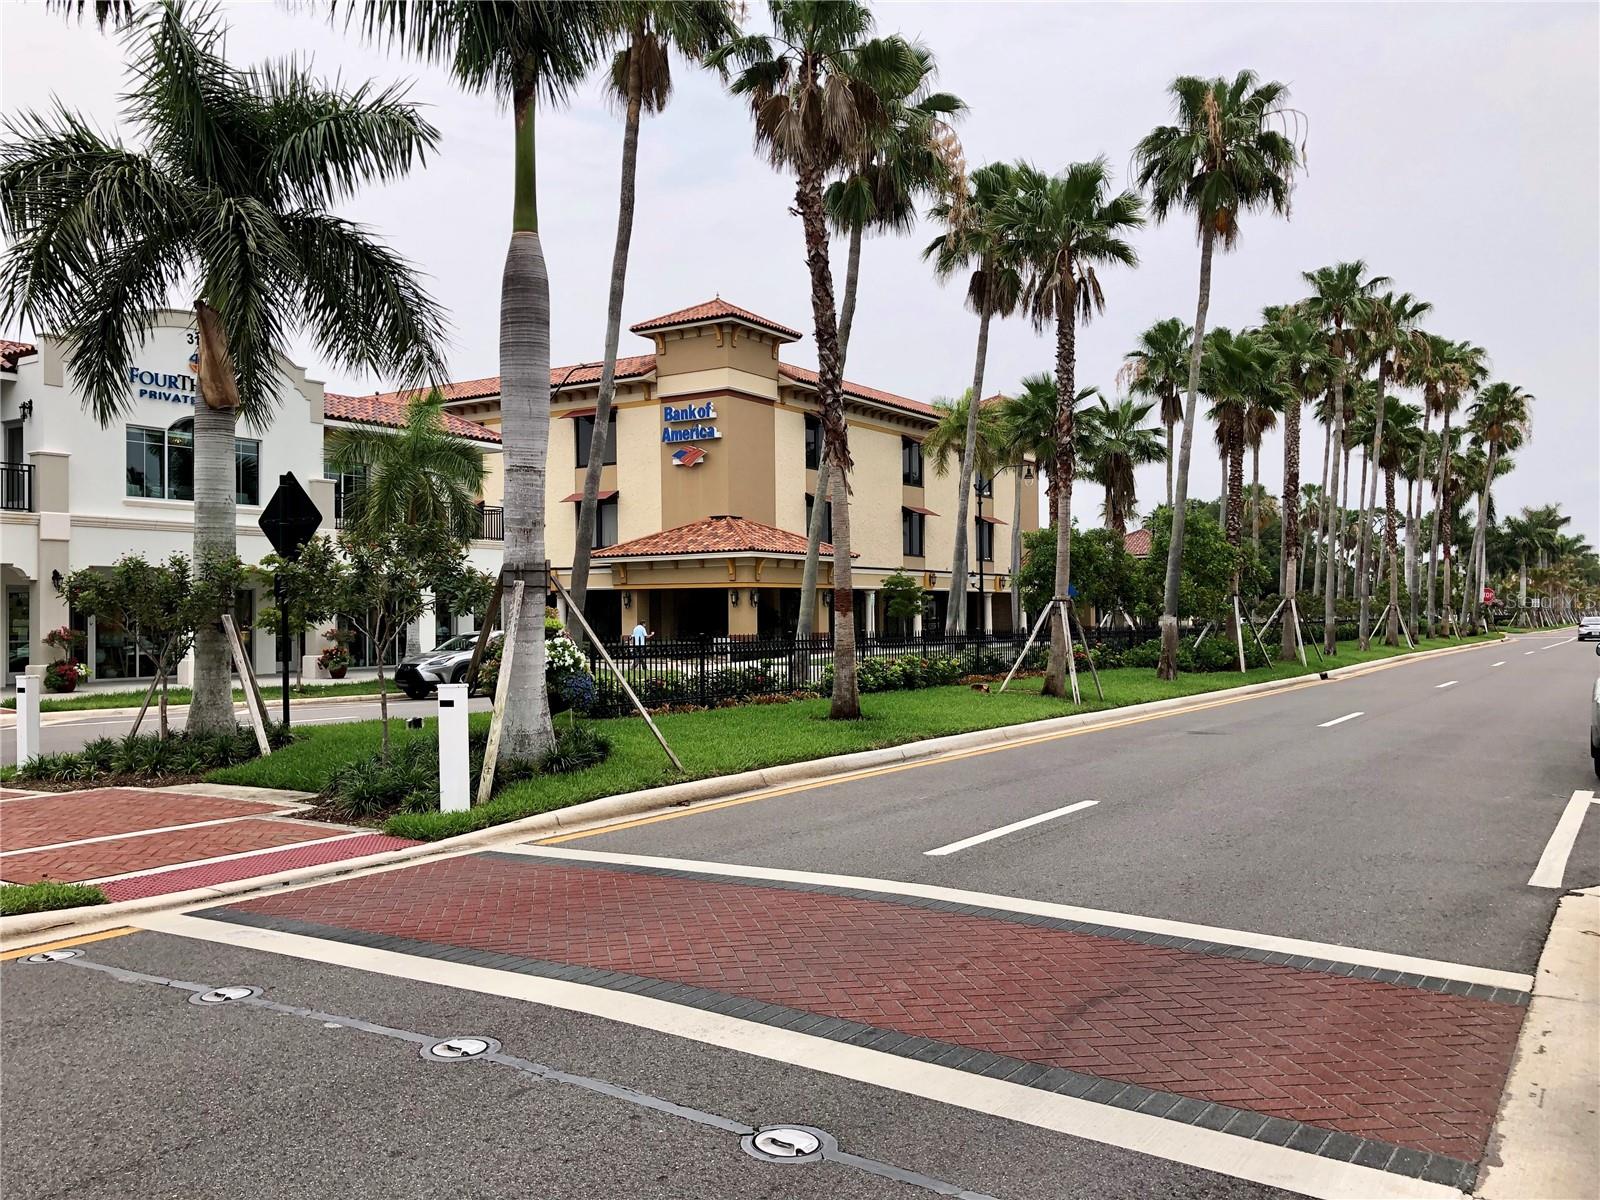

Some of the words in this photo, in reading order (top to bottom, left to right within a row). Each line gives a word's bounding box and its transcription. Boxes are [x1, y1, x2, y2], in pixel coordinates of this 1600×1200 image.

[187, 332, 199, 345] 31
[130, 367, 197, 391] FOURTH
[664, 404, 697, 421] Bank
[697, 402, 712, 418] of
[662, 424, 716, 442] America
